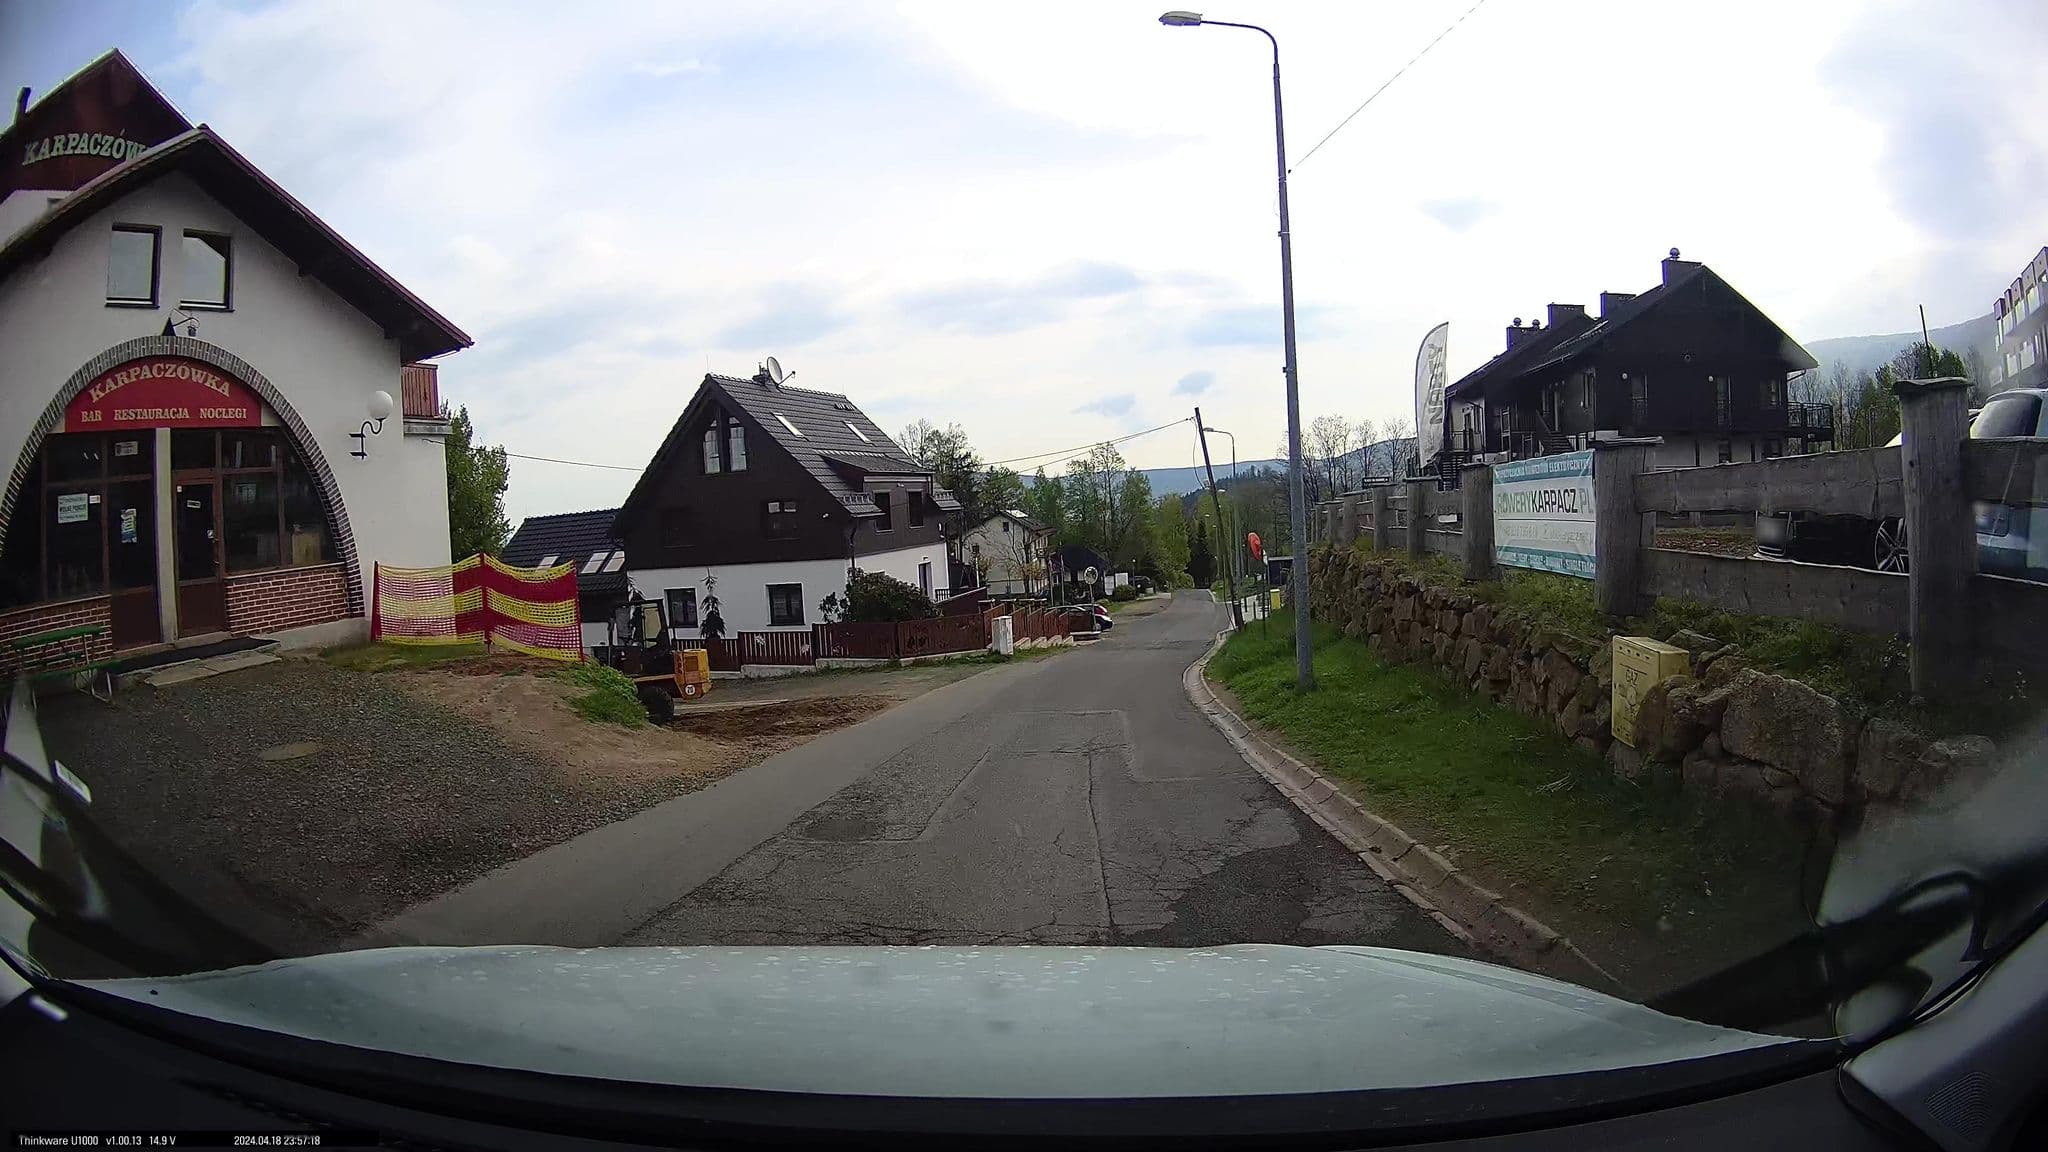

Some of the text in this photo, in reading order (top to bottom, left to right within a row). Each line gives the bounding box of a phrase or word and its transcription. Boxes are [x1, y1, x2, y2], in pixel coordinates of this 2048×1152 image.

[22, 128, 150, 166] KARPACZÓW
[89, 362, 231, 403] KARPACZÓWKA
[81, 407, 247, 423] BAR RESTAURACJA NOCLEGI
